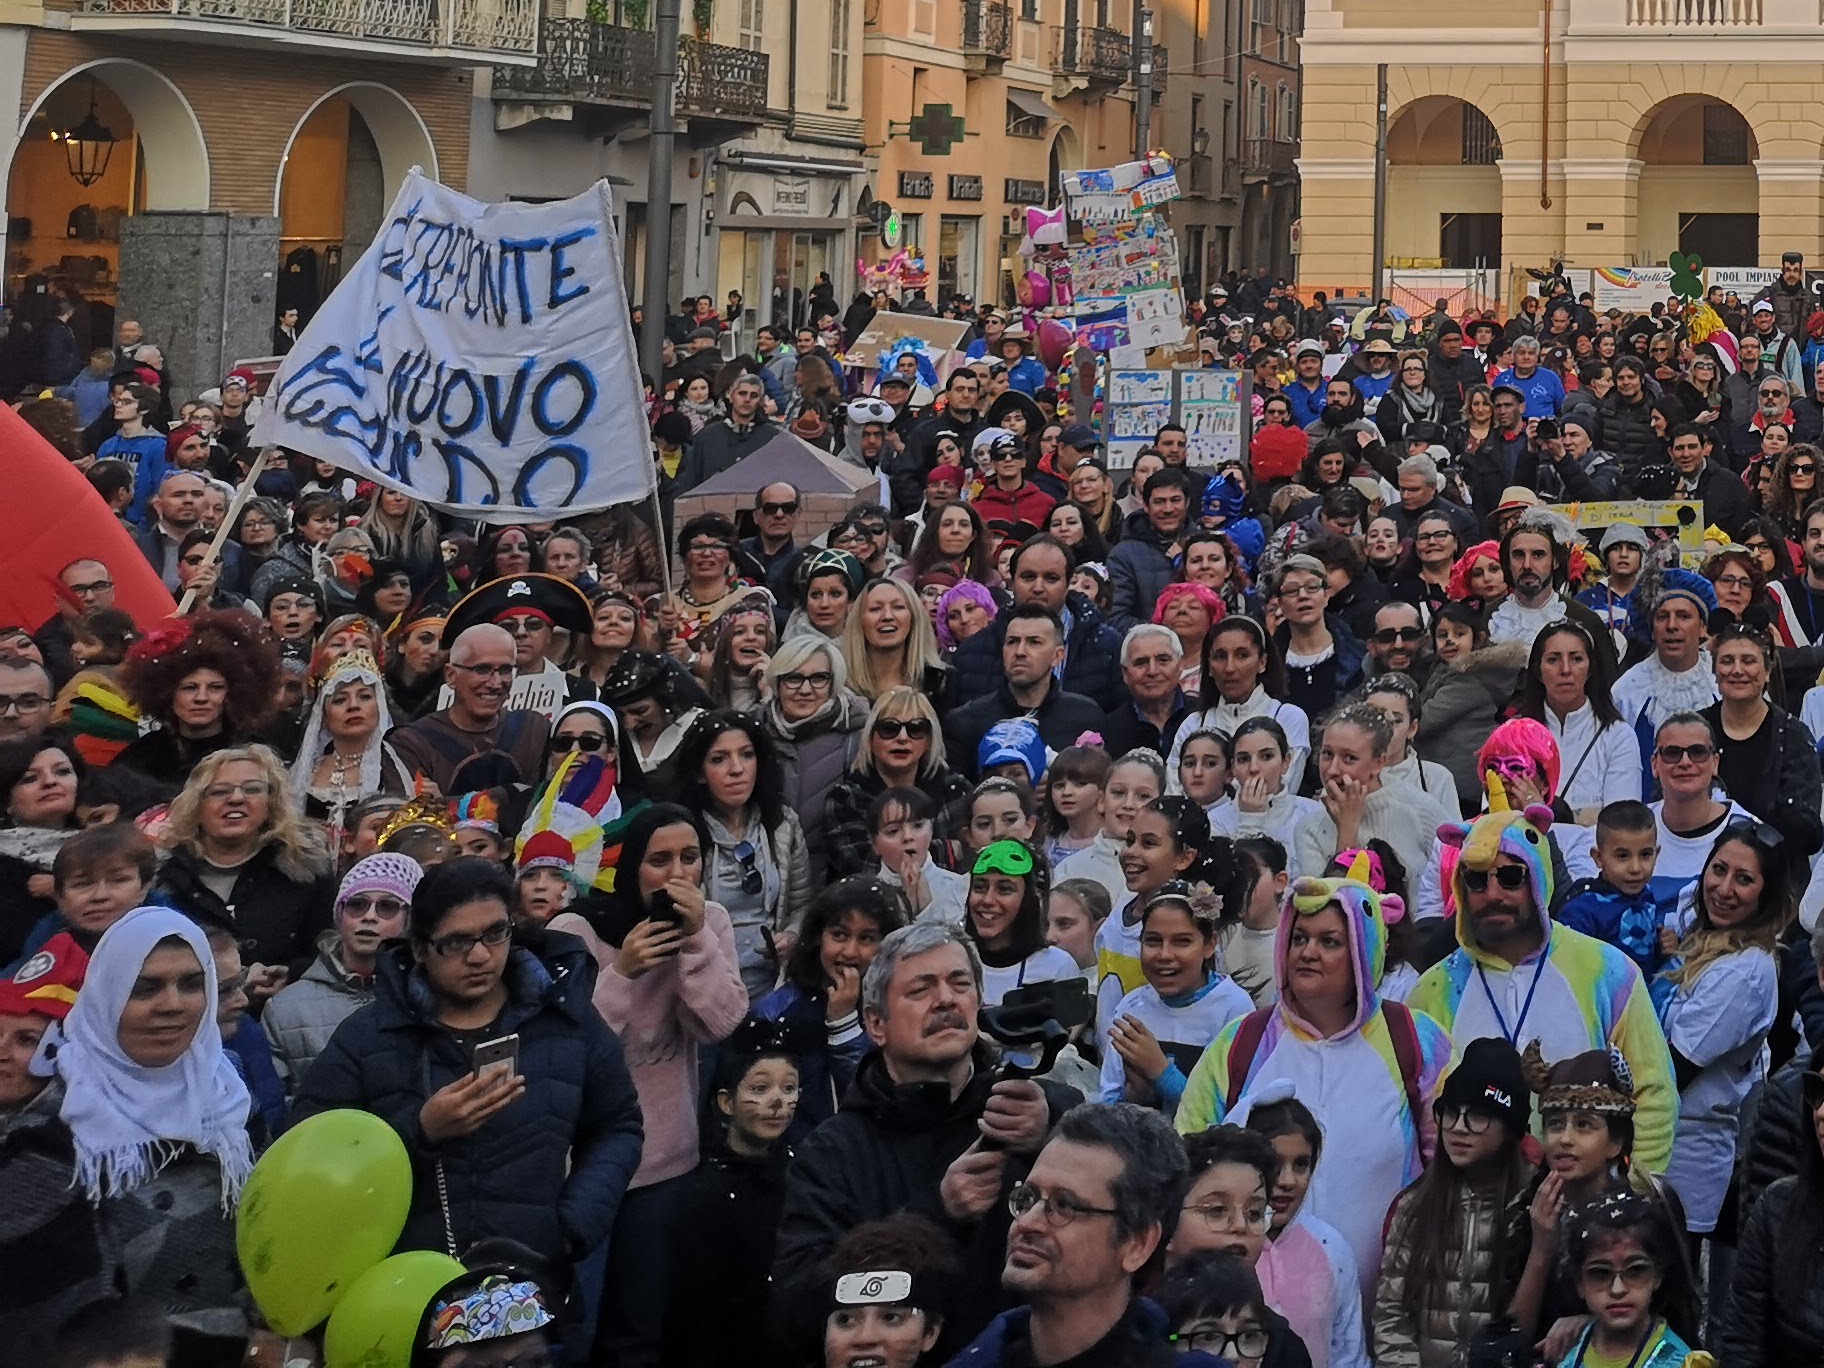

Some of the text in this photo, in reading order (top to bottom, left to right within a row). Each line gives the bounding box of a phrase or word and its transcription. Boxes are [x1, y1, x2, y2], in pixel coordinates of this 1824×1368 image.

[1715, 271, 1741, 283] POOL
[384, 354, 600, 449] NUOVO
[1484, 1084, 1512, 1108] FILA
